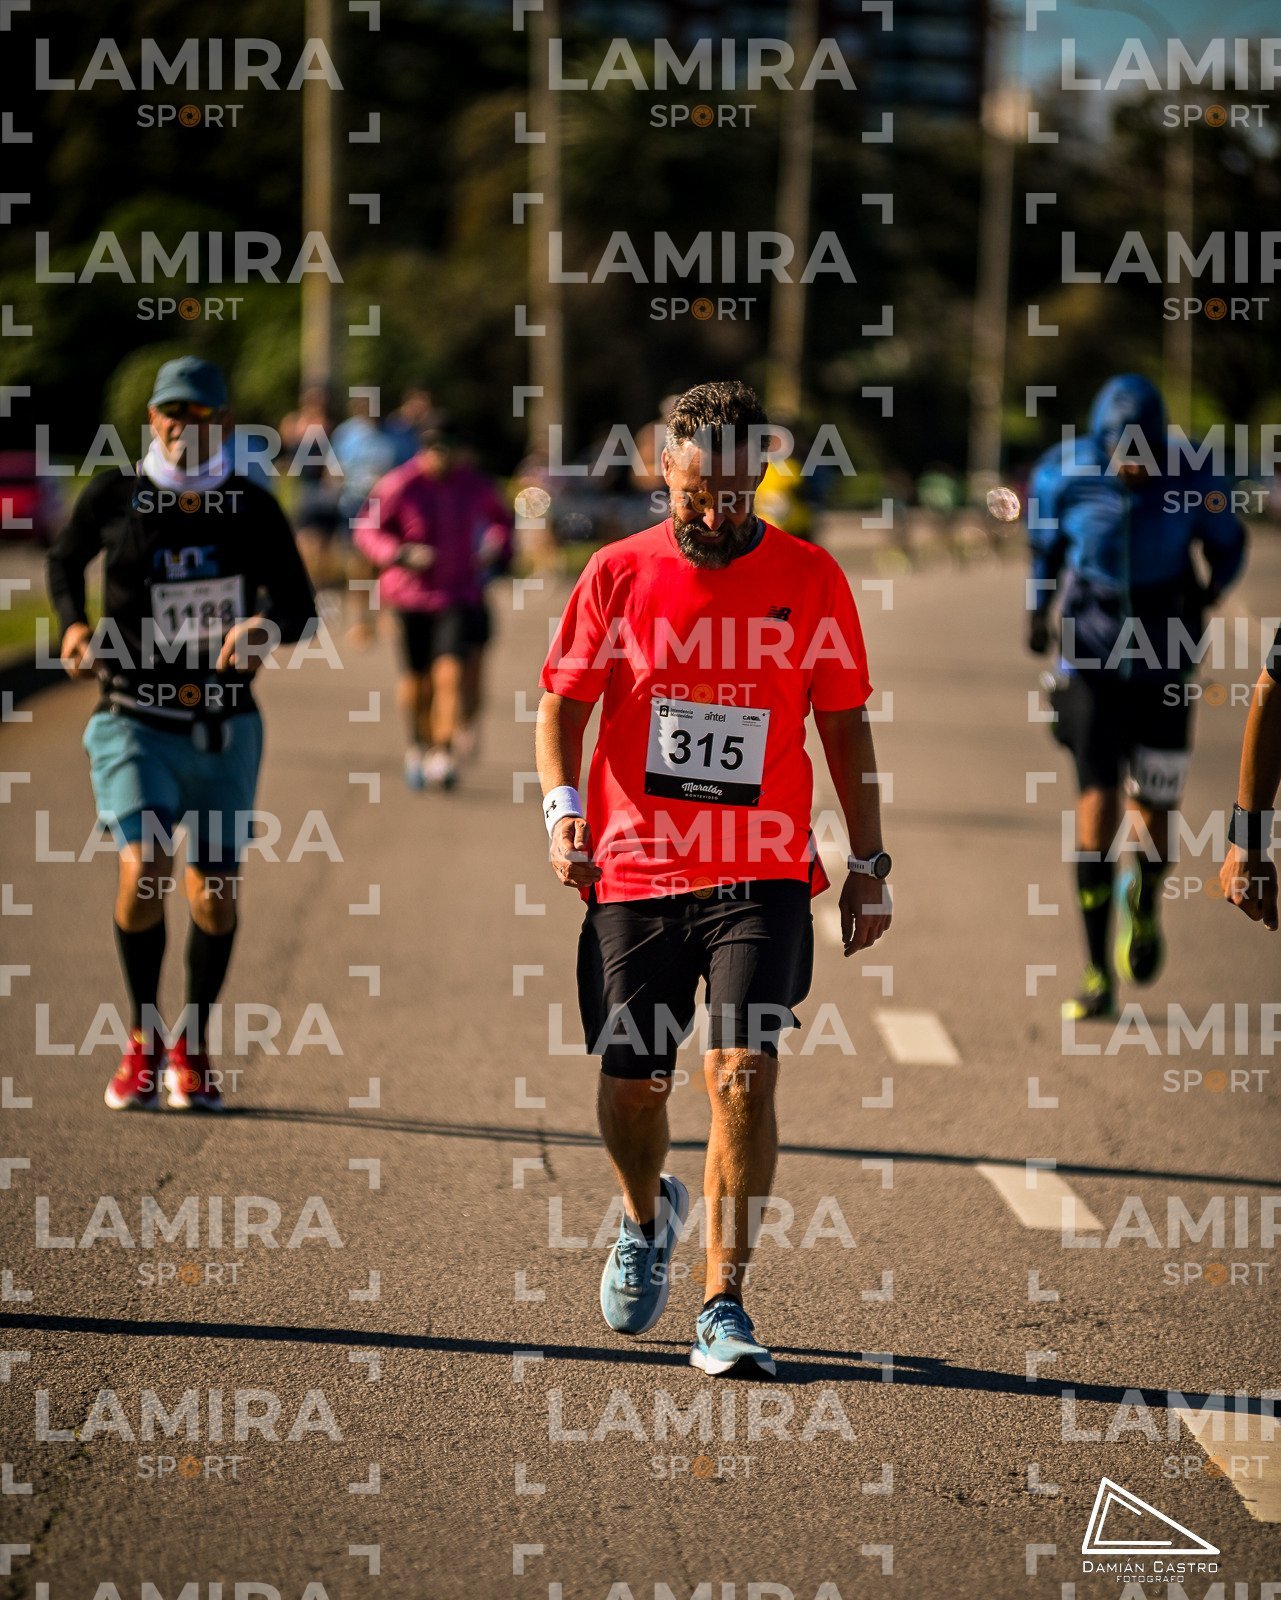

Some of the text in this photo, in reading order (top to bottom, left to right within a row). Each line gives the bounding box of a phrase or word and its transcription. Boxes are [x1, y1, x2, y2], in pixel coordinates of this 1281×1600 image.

[704, 712, 726, 722] antel
[668, 729, 744, 770] 315
[681, 782, 723, 796] Maratón
